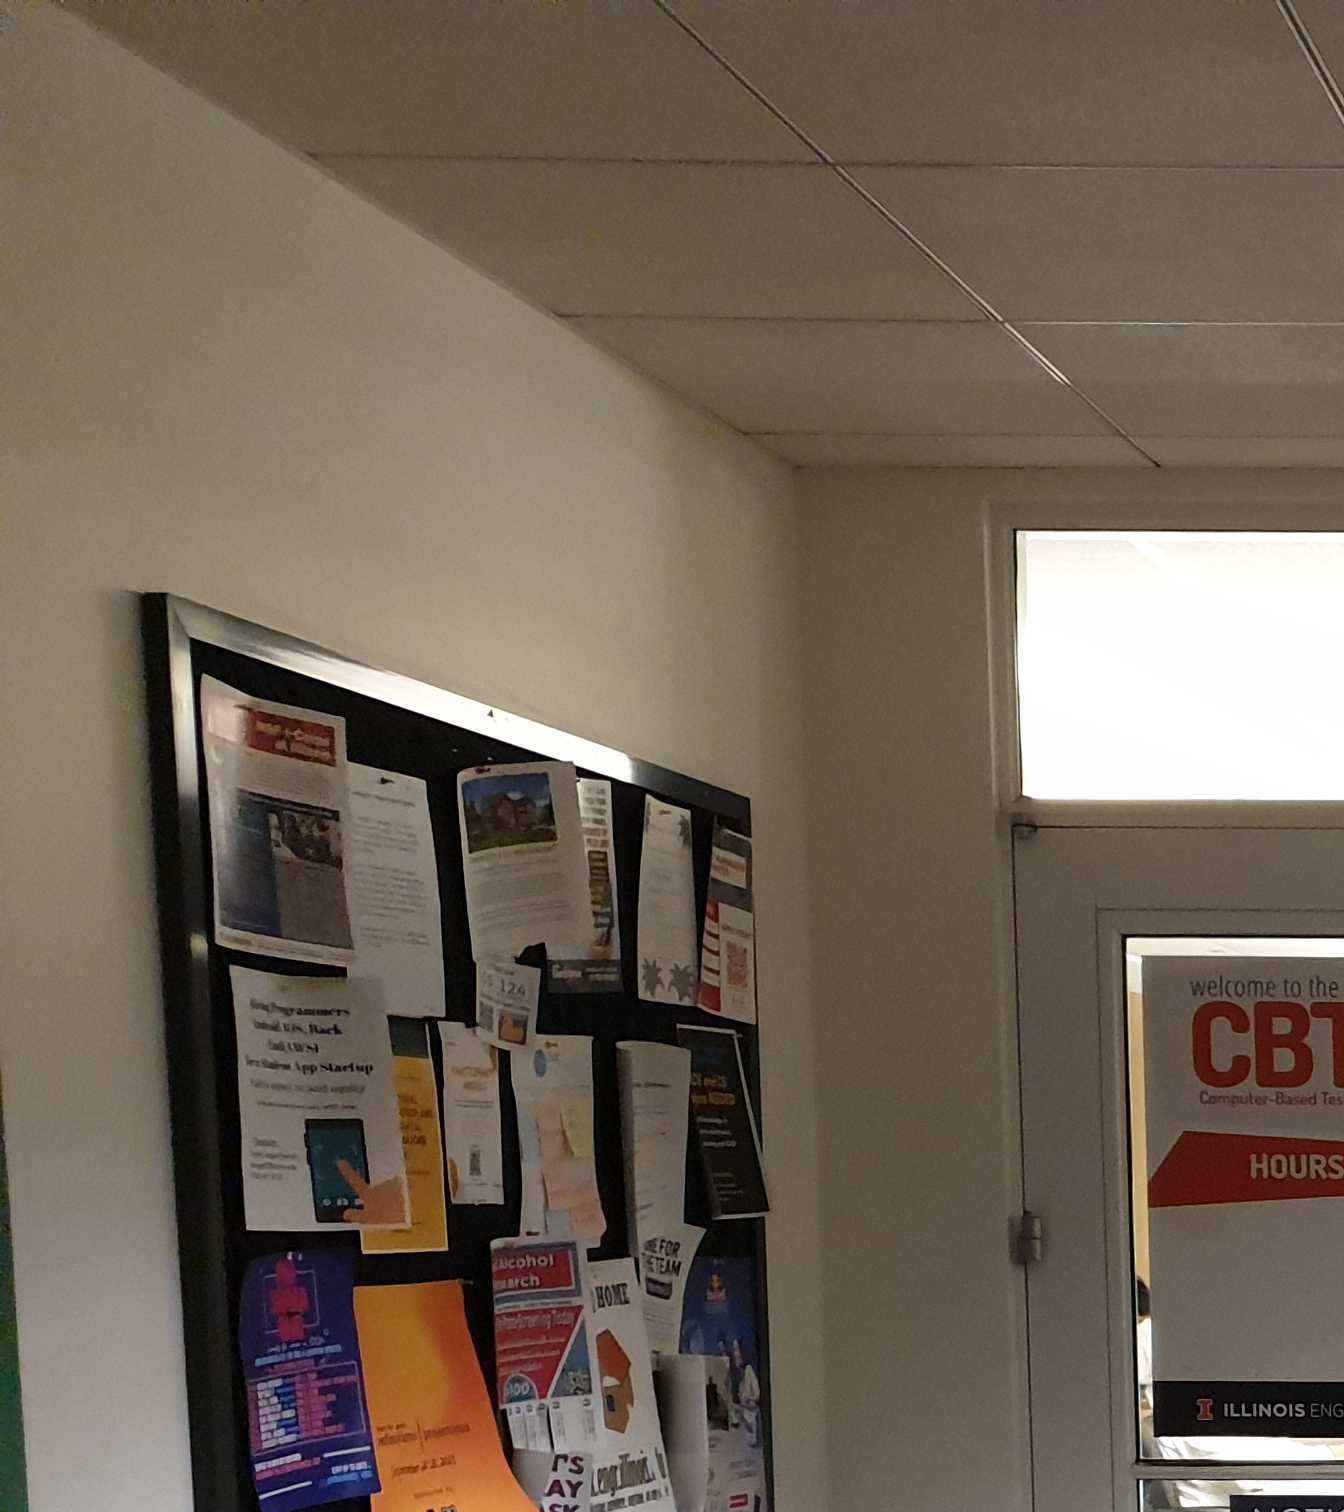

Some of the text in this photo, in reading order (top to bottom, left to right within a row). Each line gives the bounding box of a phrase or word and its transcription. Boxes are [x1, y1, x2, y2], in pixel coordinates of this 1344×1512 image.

[1189, 976, 1340, 999] welcome to the
[319, 1063, 374, 1076] Startup
[1199, 1091, 1316, 1108] Computer-Based
[1250, 1154, 1344, 1181] HOURS
[659, 1239, 681, 1258] FOR
[1223, 1403, 1306, 1419] ILLINOIS
